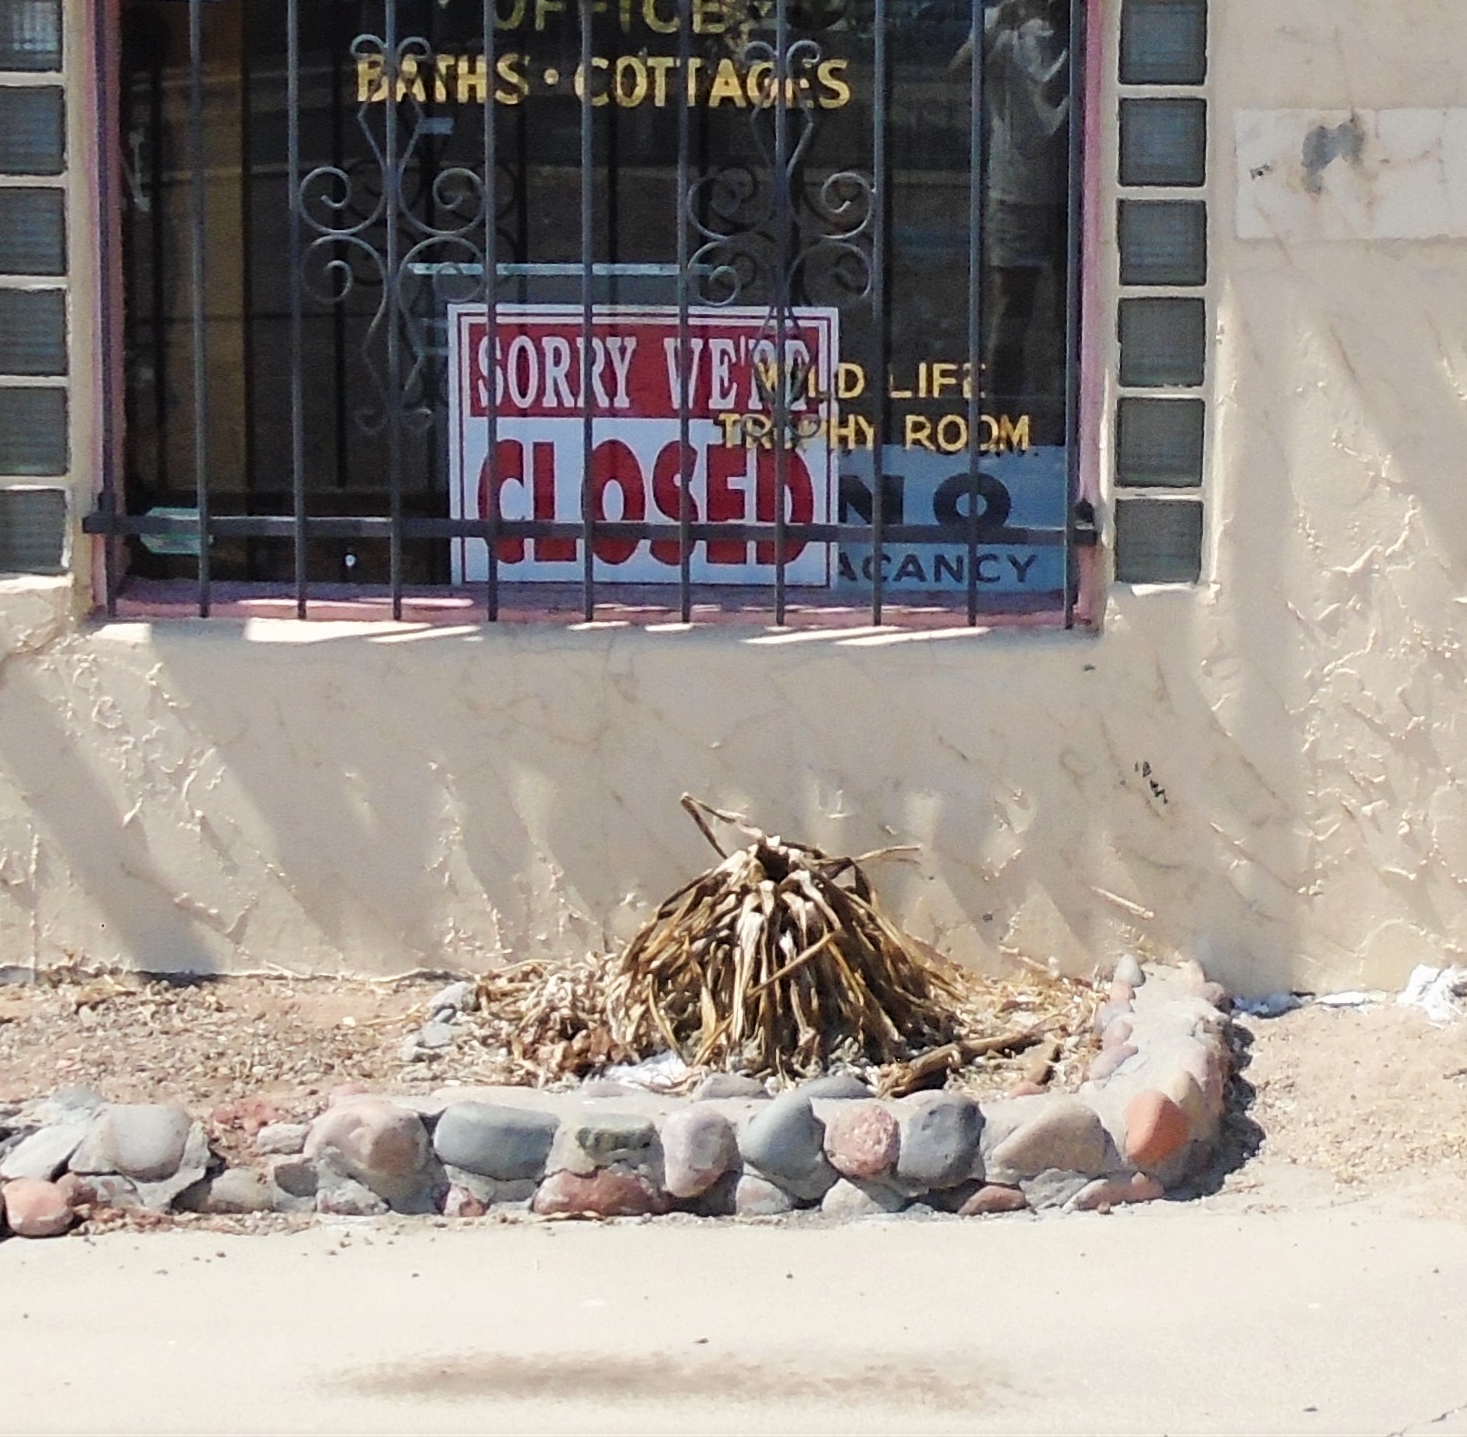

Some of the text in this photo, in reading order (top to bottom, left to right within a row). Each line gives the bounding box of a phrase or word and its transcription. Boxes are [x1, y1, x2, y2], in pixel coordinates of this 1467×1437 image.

[357, 53, 530, 105] BATHS
[477, 334, 638, 410] SORRY
[755, 362, 986, 400] WLD LIFE
[718, 413, 1030, 452] TRPHY ROOM
[476, 437, 815, 566] CLOSED
[838, 472, 1012, 535] NO
[838, 551, 1037, 584] ACANCY
